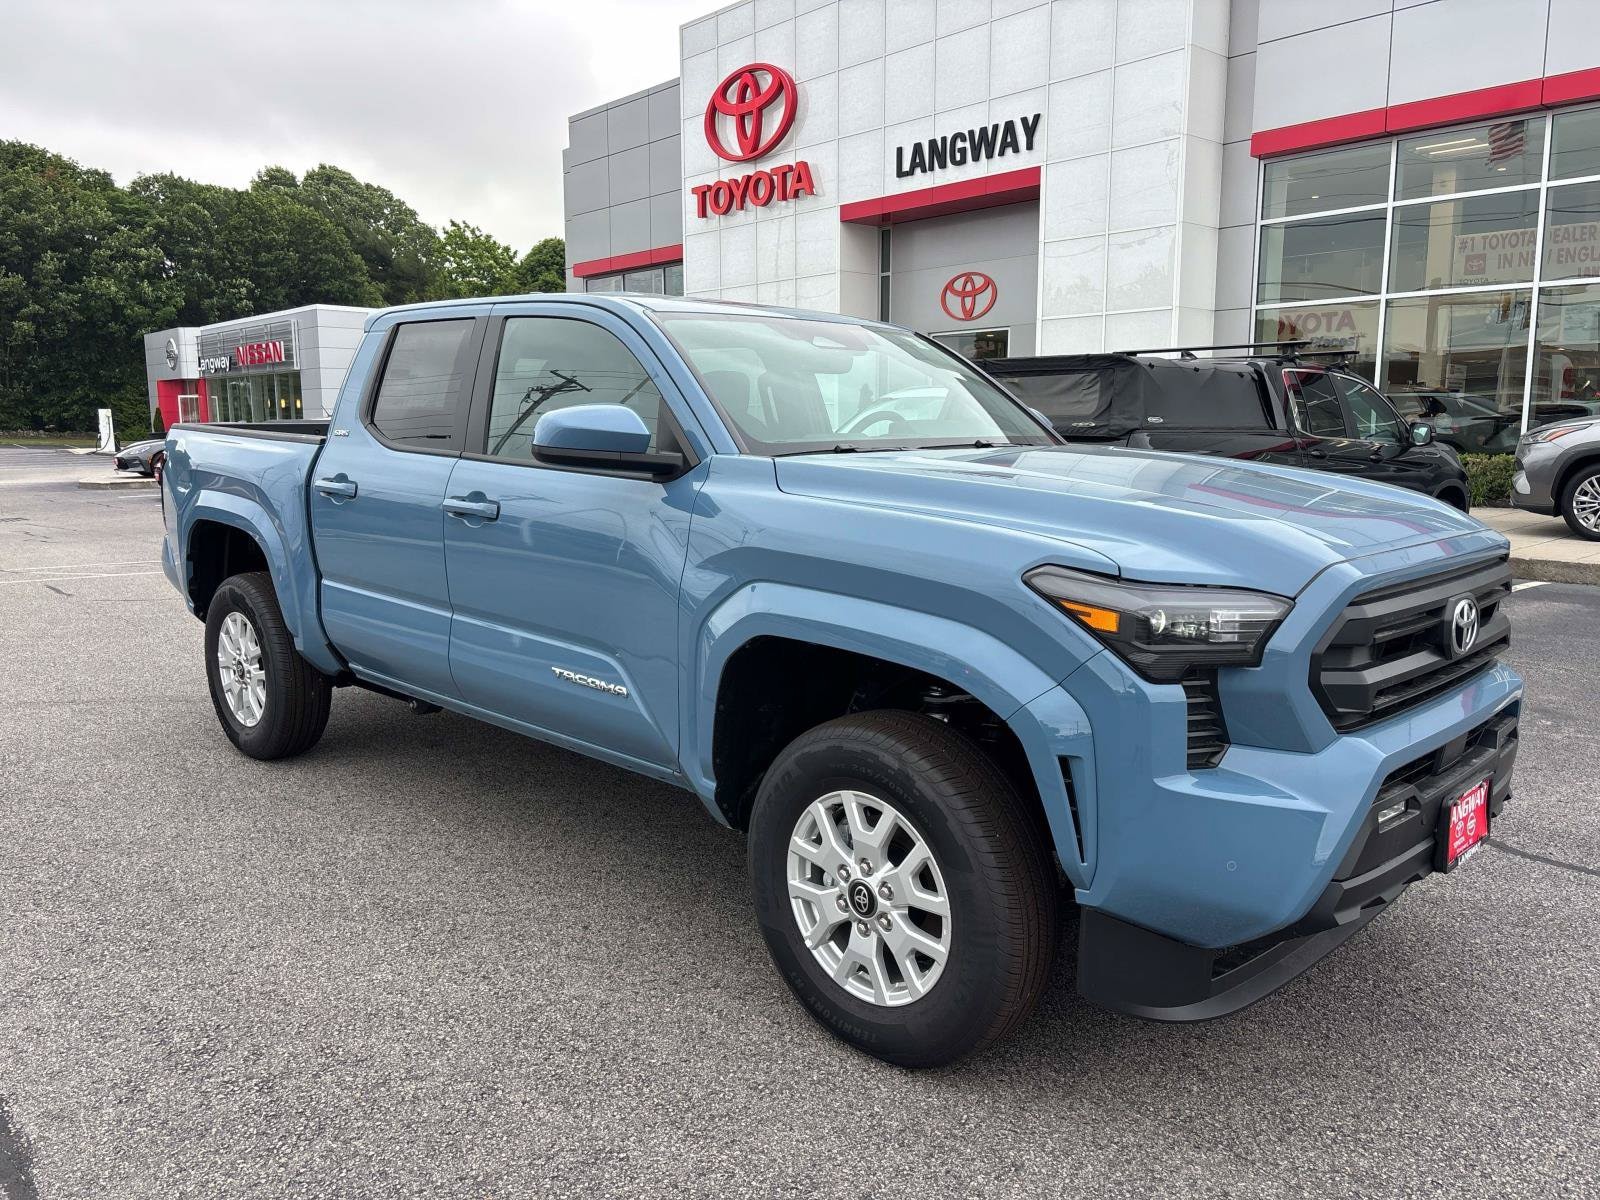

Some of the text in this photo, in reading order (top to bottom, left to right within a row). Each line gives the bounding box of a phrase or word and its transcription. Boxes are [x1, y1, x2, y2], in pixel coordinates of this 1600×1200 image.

[896, 113, 1042, 179] LANGWAY
[691, 160, 817, 218] TOYOTA
[1458, 224, 1598, 253] #1 TOYOTA EALER
[1497, 253, 1514, 270] IN
[1556, 245, 1600, 265] ENGL
[197, 341, 285, 374] Langway NISSAN
[551, 666, 629, 698] TACOMA
